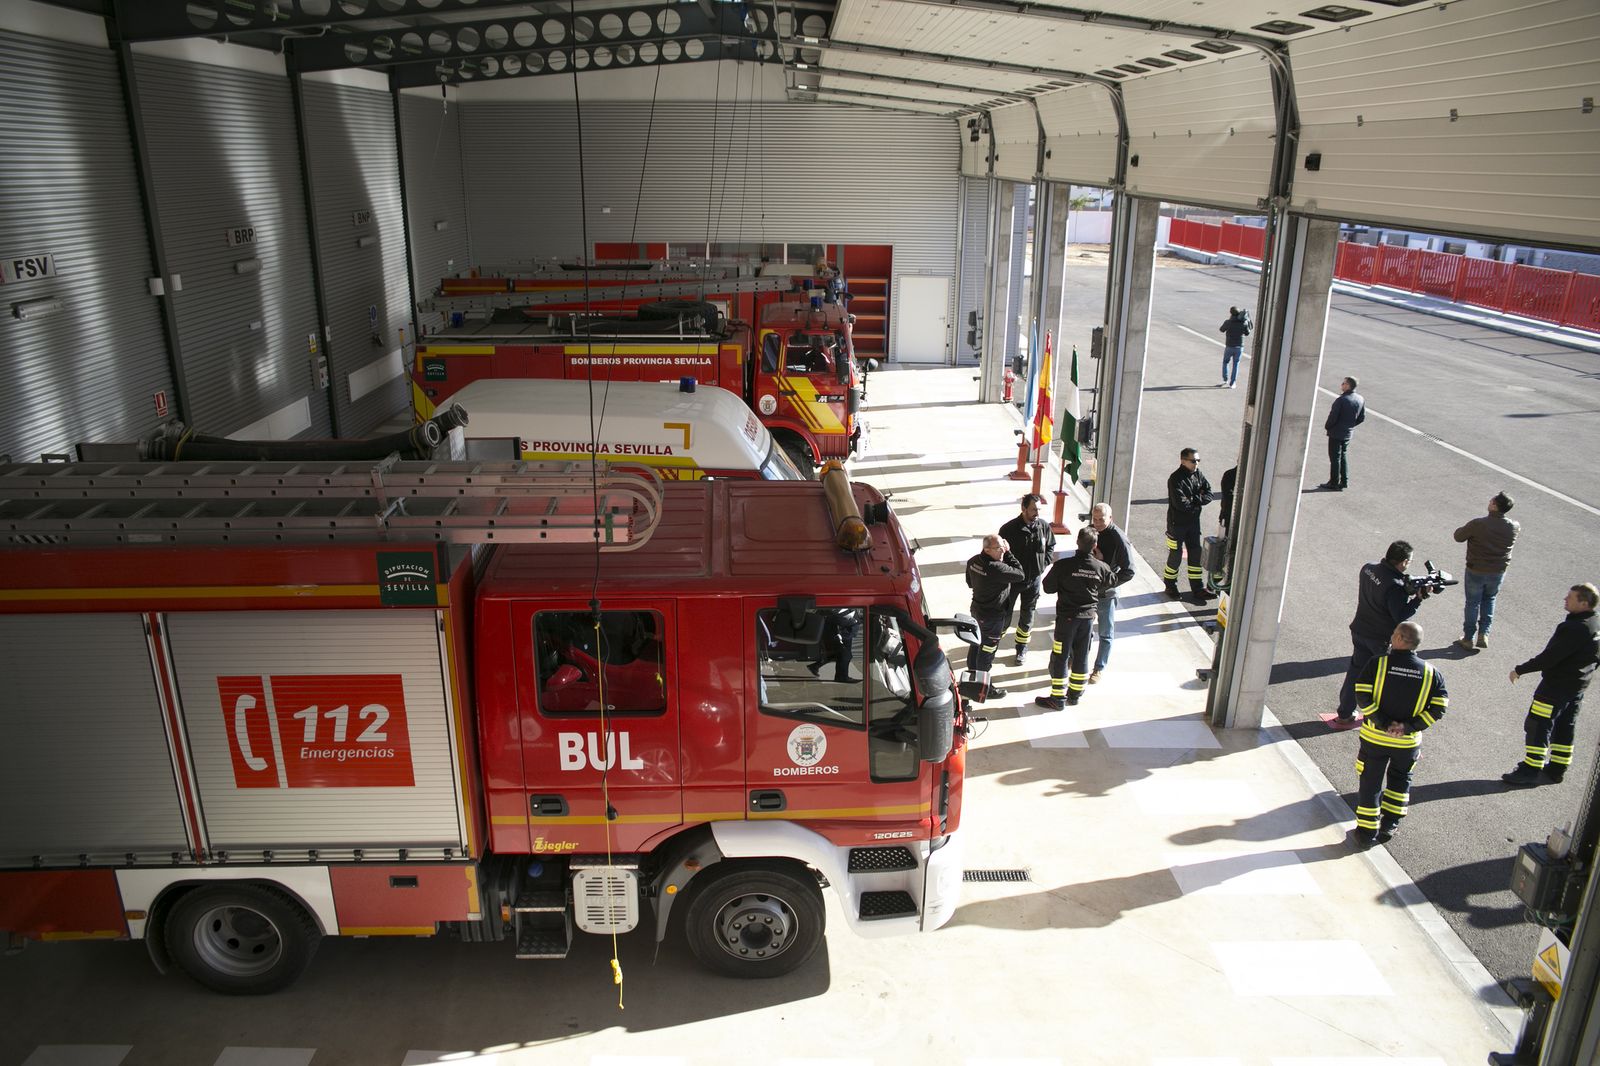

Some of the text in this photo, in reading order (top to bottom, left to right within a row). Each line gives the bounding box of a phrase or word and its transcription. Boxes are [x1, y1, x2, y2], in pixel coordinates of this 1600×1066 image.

[234, 228, 254, 244] BRP
[13, 256, 47, 279] FSV
[571, 357, 712, 365] BOMBEROS PROVINCIA SEVILLA
[533, 441, 610, 454] PROVINCIA
[614, 444, 673, 456] SEVILLA
[293, 703, 390, 743] 112
[300, 746, 395, 762] Emergencias
[558, 731, 644, 771] BUL
[773, 765, 839, 777] BOMBEROS
[873, 831, 913, 839] 120E25
[533, 837, 579, 853] Ziegler
